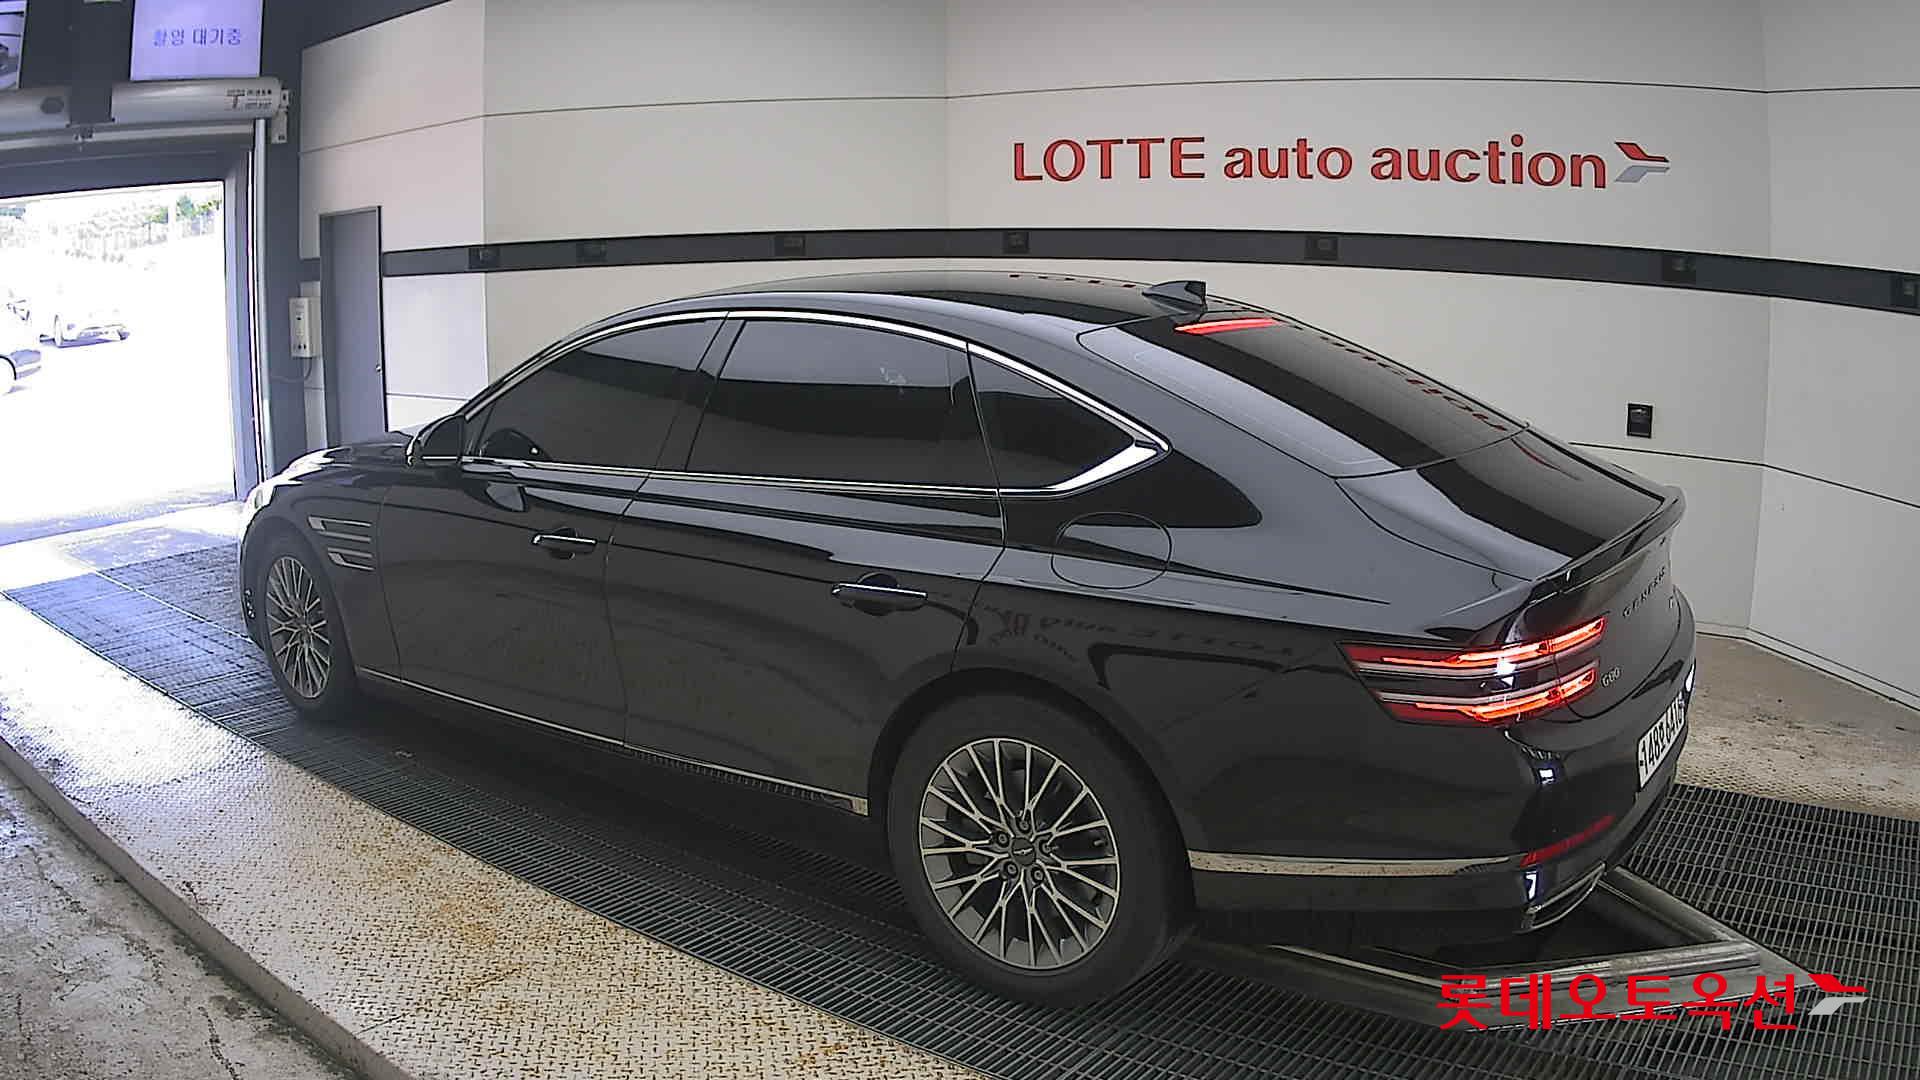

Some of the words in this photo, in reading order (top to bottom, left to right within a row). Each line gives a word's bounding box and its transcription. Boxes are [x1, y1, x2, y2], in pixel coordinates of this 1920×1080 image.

[192, 27, 242, 47] 대기중
[1013, 136, 1206, 182] LOTTE
[1222, 137, 1354, 181] auto
[1369, 133, 1607, 190] auction
